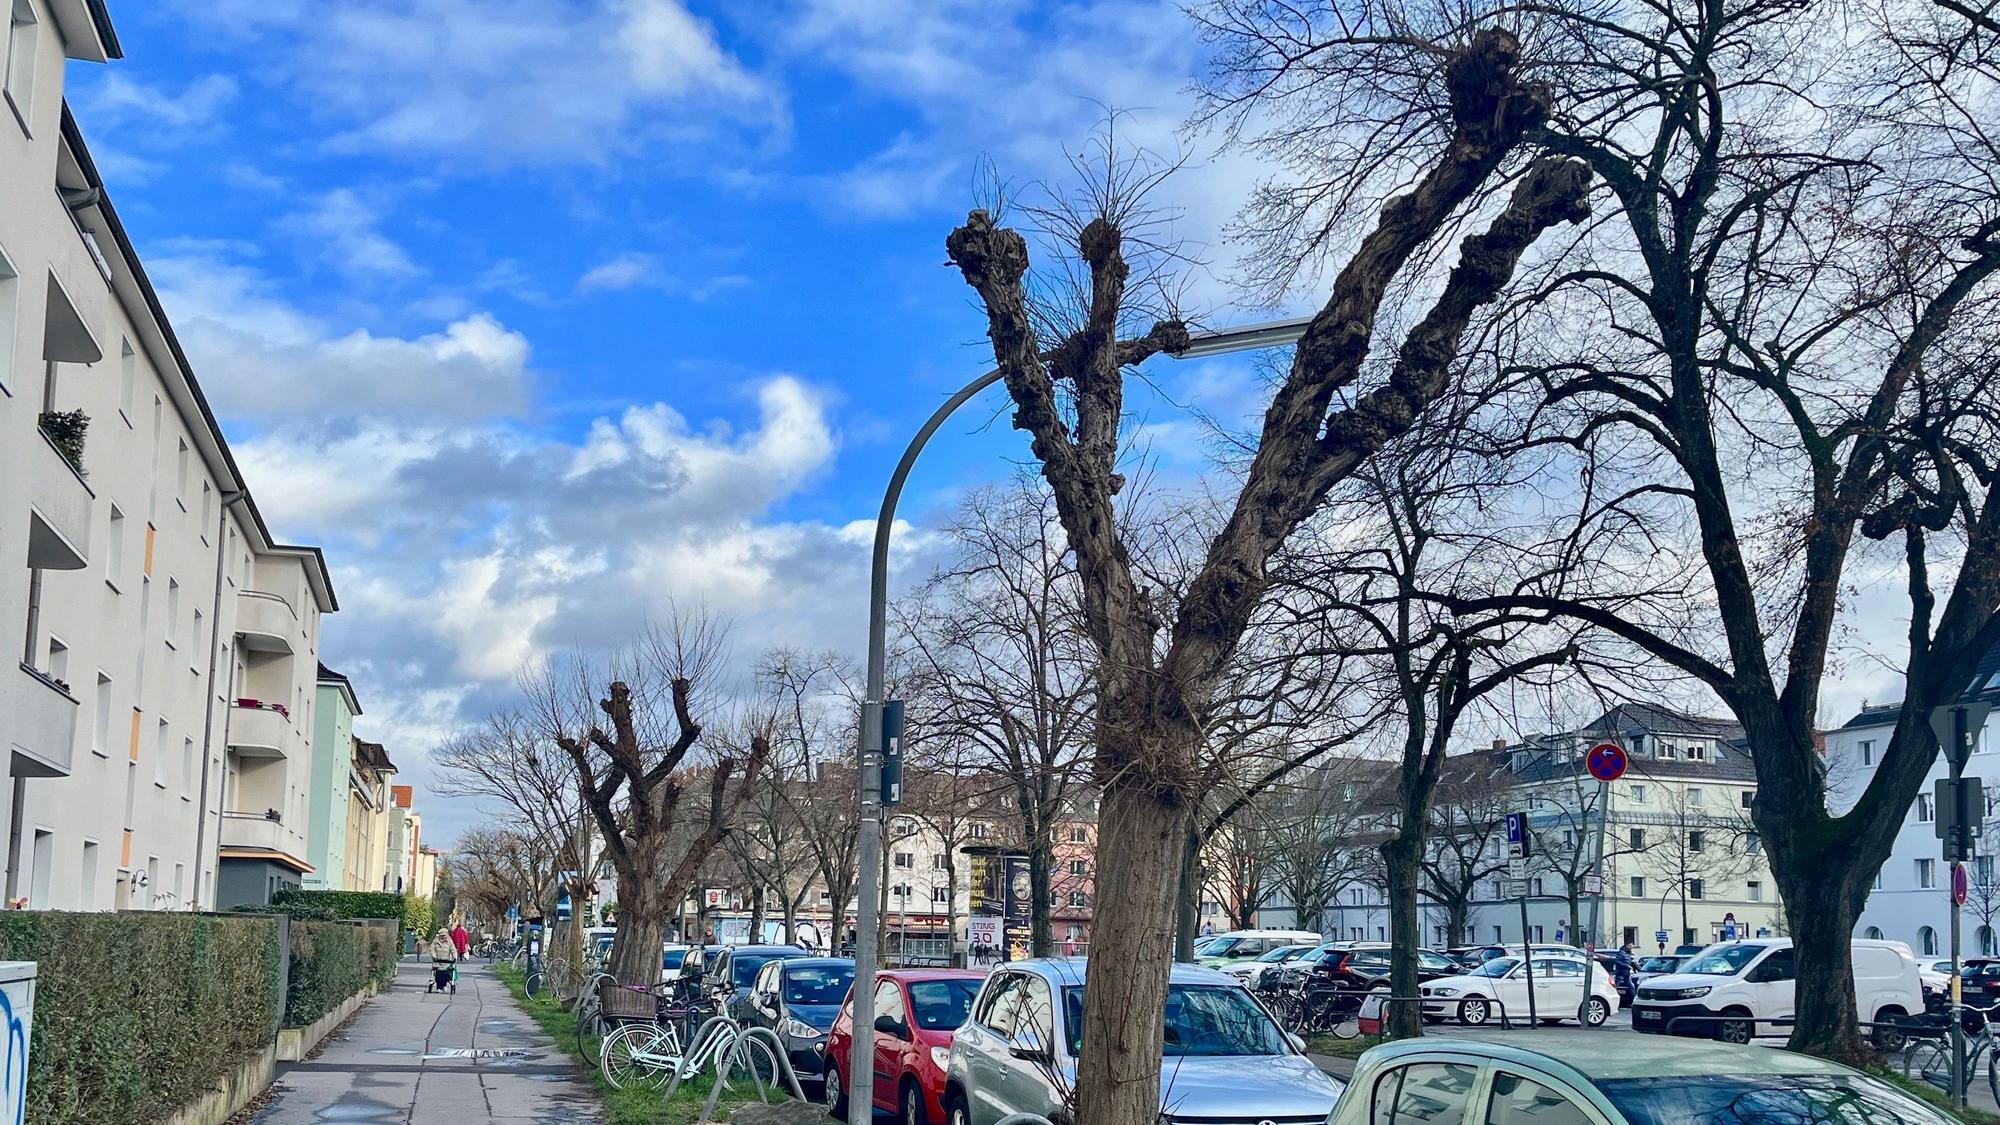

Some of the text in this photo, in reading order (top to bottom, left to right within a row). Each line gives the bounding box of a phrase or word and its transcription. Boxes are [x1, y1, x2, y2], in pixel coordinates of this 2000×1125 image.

[1509, 817, 1517, 838] P
[972, 922, 995, 930] STING
[973, 932, 992, 943] 3.0
